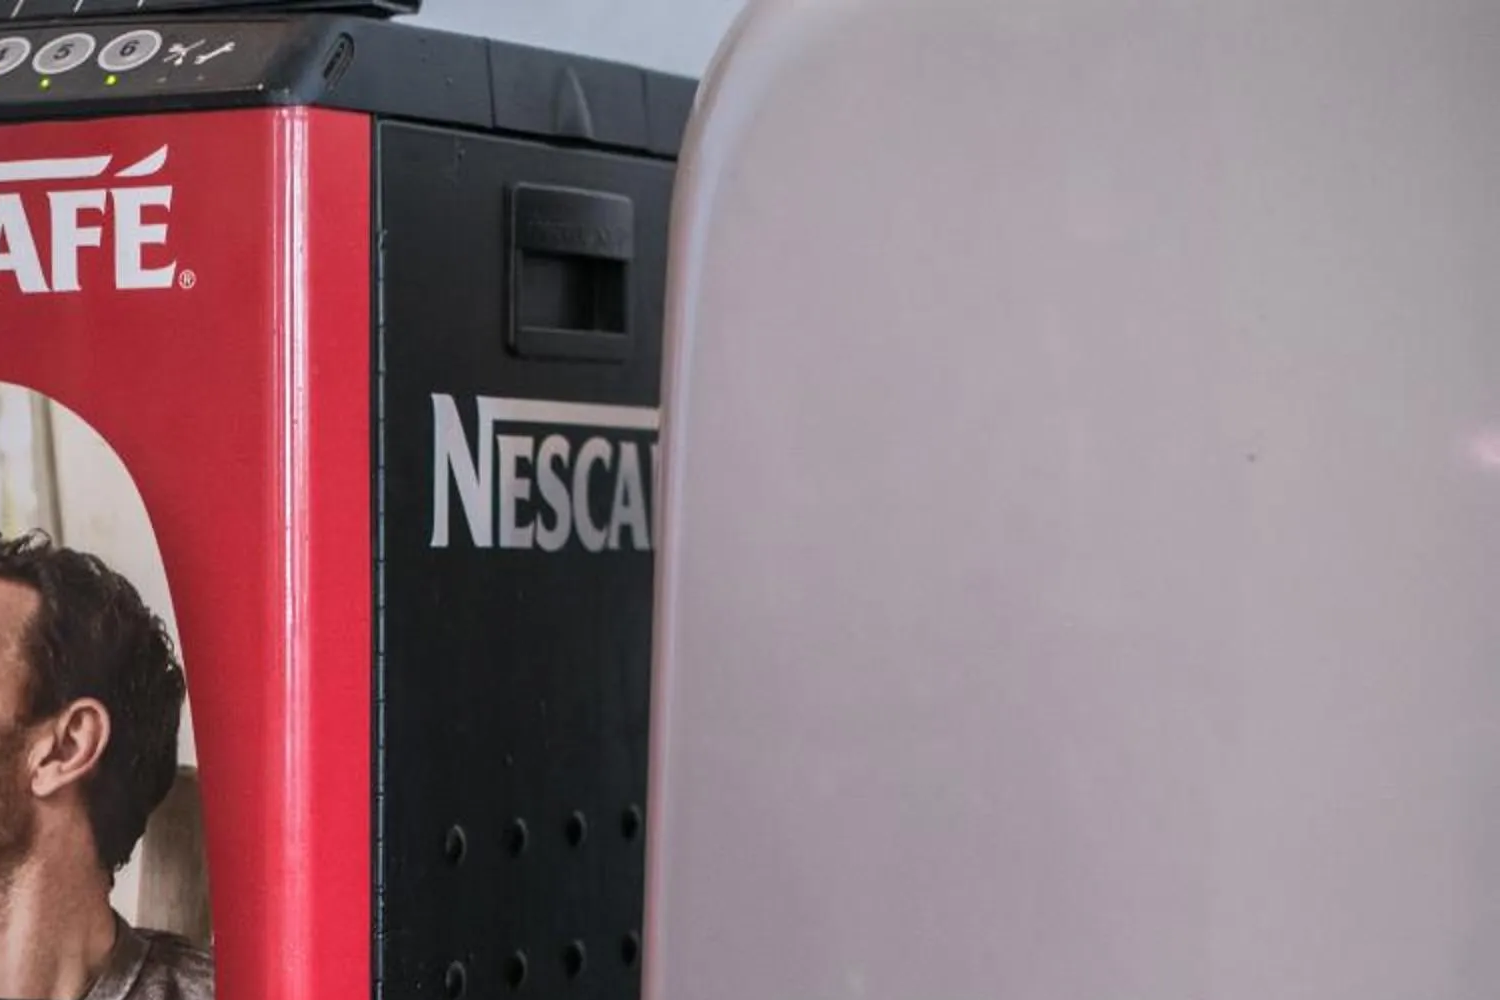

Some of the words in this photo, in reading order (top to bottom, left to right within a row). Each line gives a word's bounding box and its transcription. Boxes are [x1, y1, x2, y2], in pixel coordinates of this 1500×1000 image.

[52, 42, 76, 60] 5
[119, 38, 141, 58] 6
[430, 392, 660, 552] NESCA
